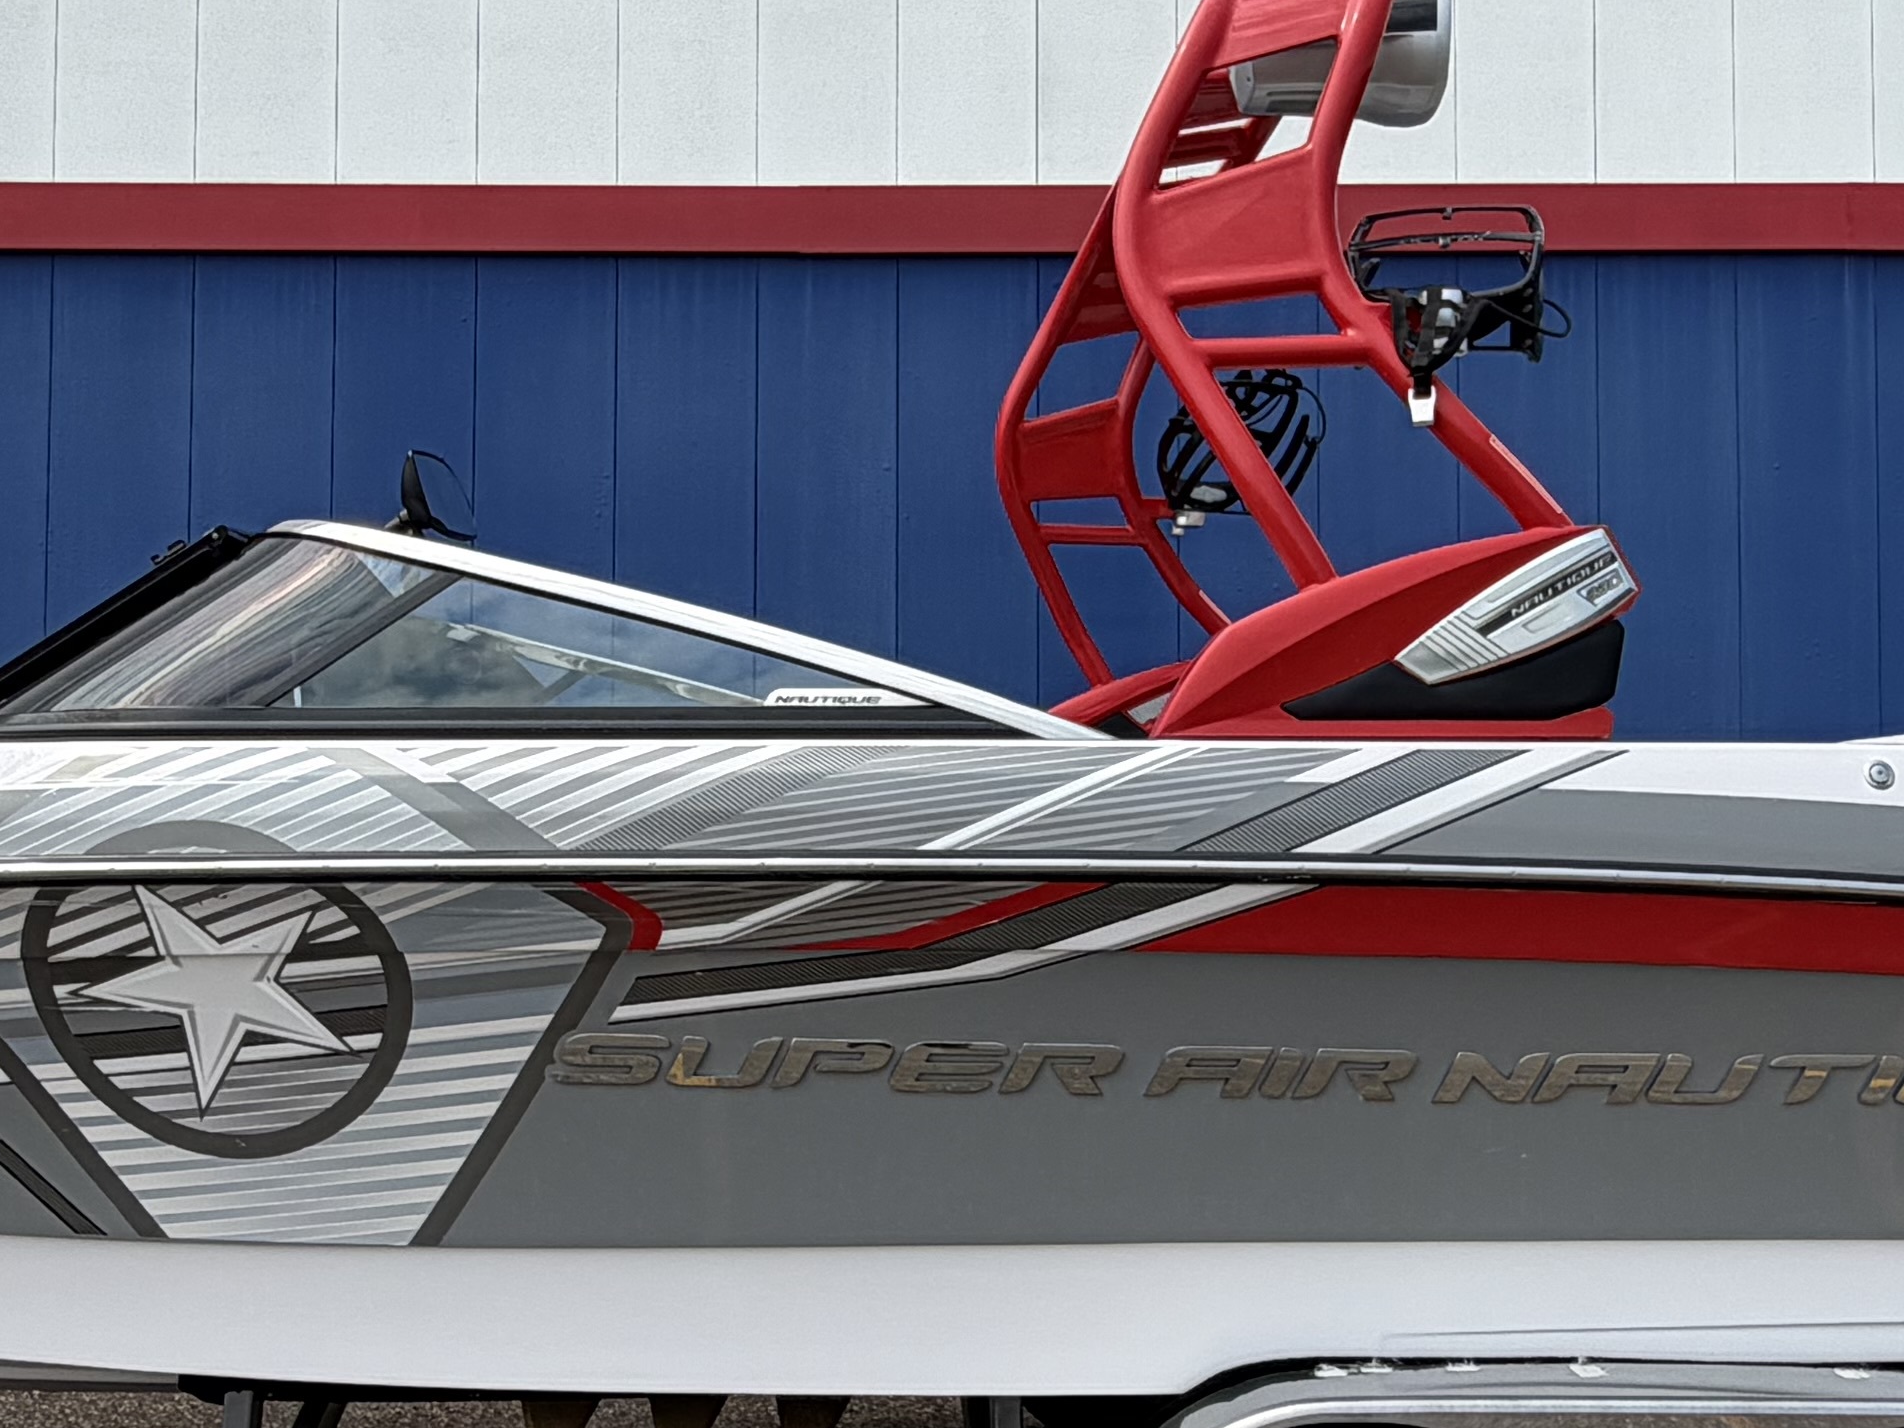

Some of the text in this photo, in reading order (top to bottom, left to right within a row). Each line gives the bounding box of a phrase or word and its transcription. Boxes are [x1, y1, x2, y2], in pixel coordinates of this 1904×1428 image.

[1511, 554, 1612, 617] NAUTIQUE
[775, 695, 882, 705] NAUTIQUE
[543, 1030, 1124, 1097] SUPER
[1142, 1045, 1419, 1103] AIR
